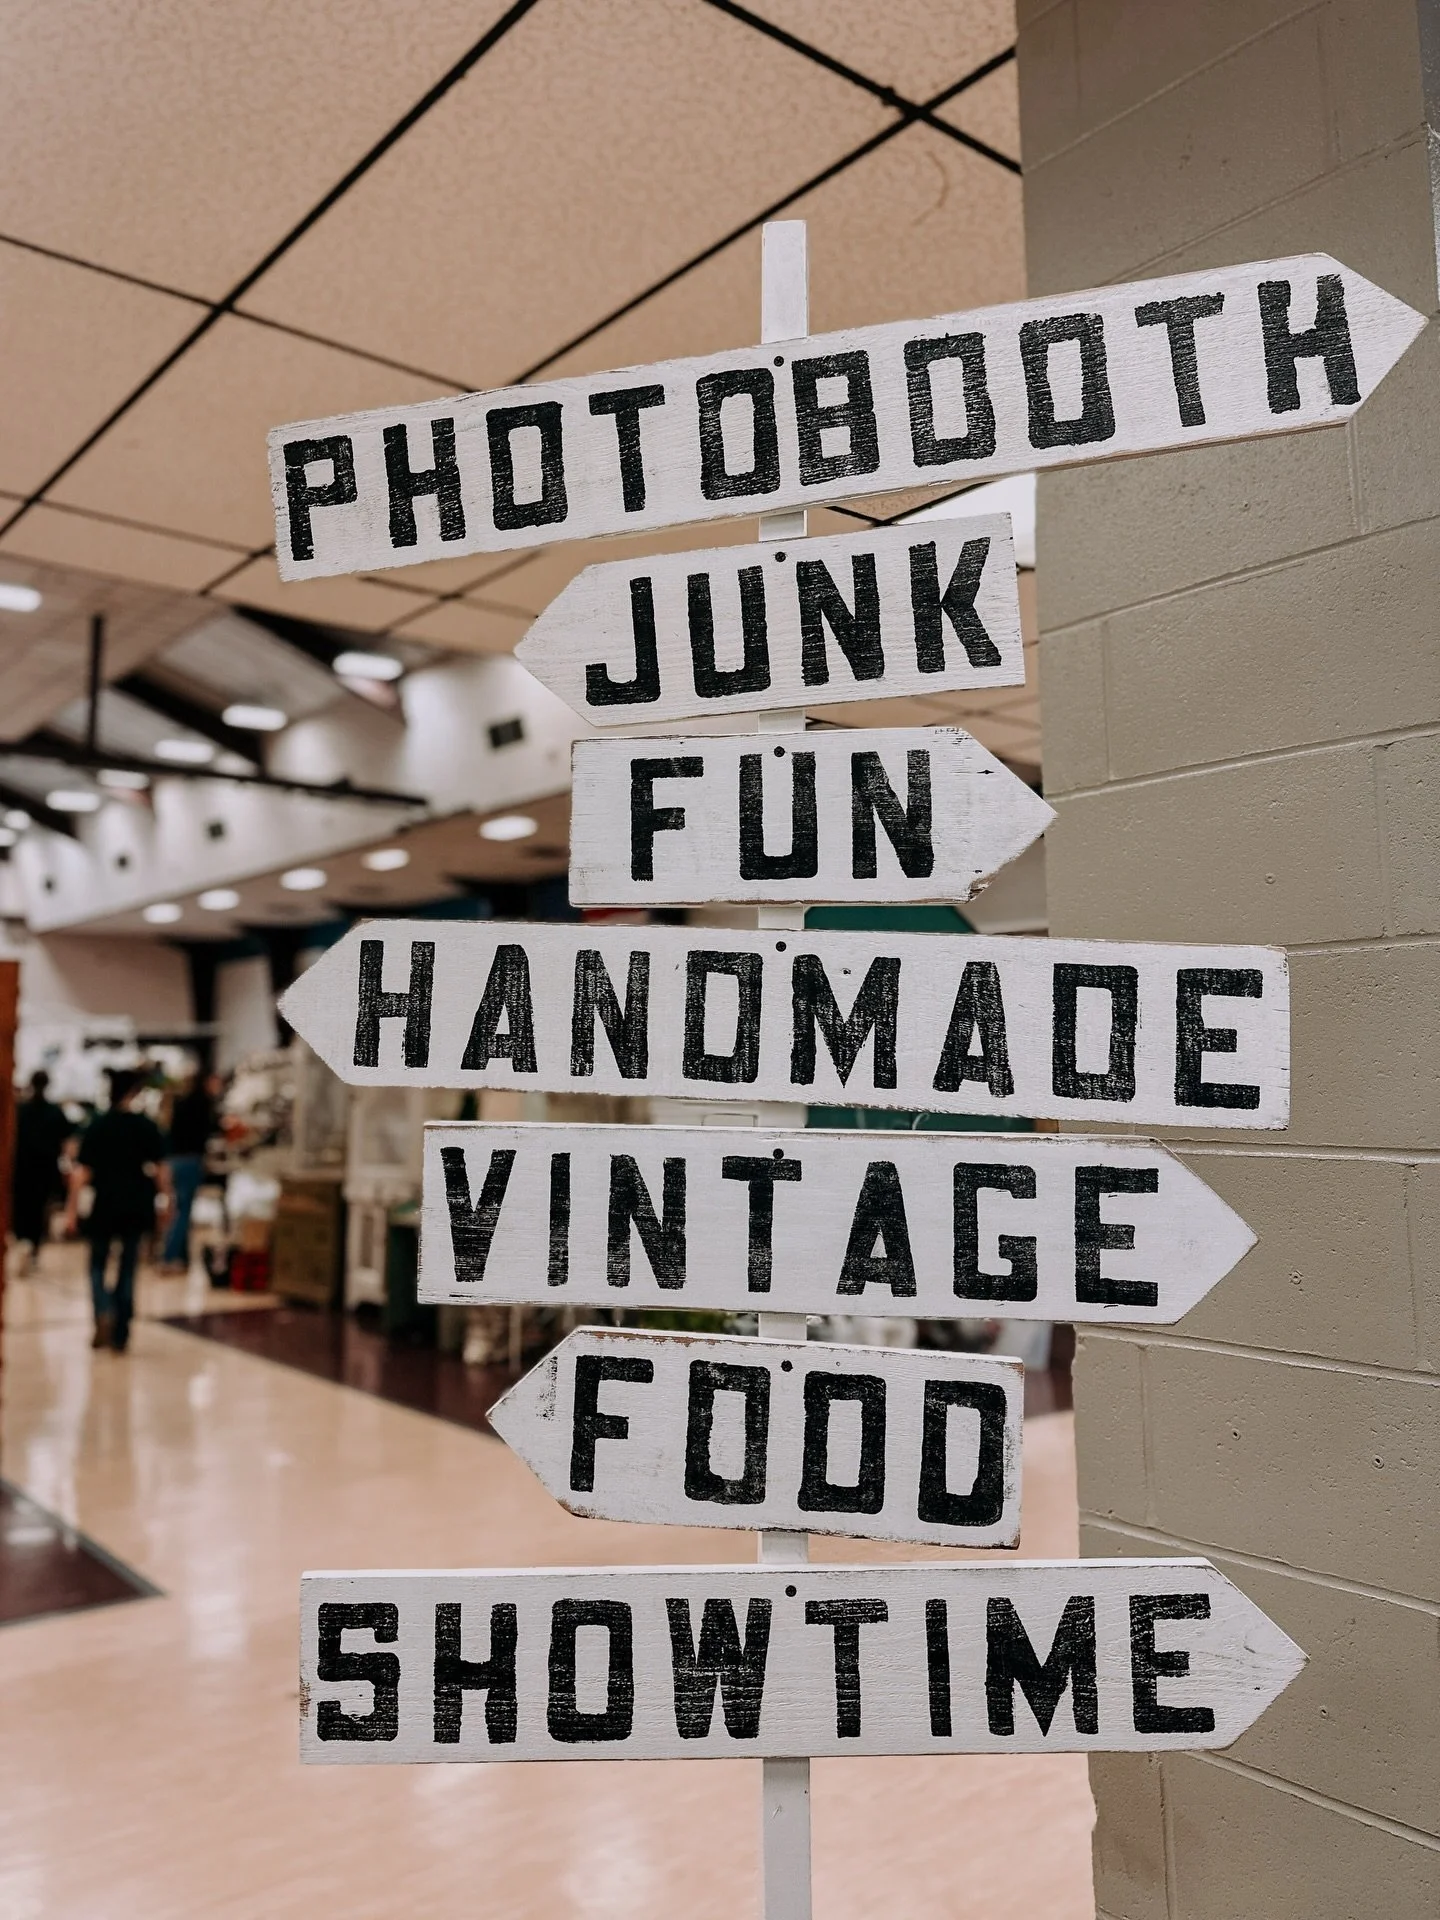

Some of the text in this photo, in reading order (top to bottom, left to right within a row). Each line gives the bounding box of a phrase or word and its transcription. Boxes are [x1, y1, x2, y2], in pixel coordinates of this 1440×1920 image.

[283, 274, 1361, 561] PHOTOBOOTH
[586, 537, 1002, 706] JUNK
[631, 750, 936, 881] FUN
[353, 940, 1263, 1110] HANDMADE
[440, 1147, 1159, 1305] VINTAGE
[570, 1355, 1006, 1526] FOOD
[317, 1593, 1215, 1743] SHOWTIME
